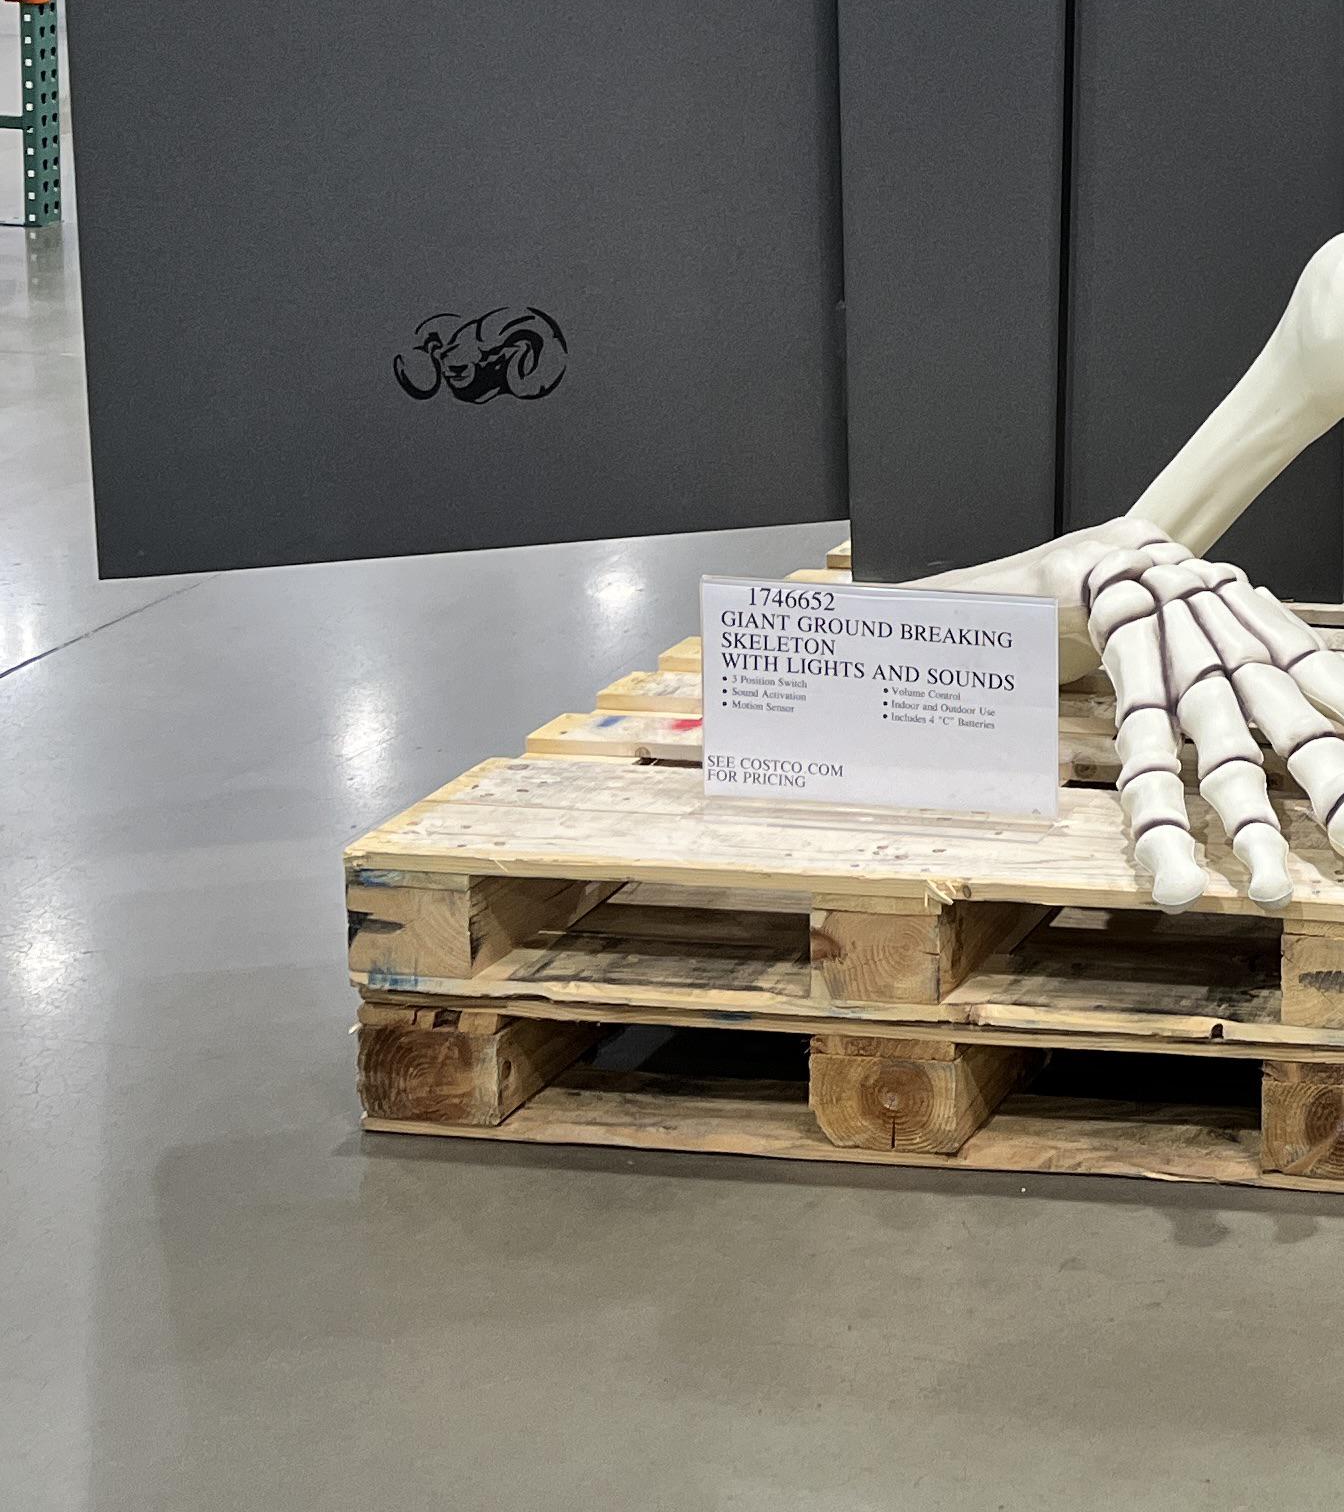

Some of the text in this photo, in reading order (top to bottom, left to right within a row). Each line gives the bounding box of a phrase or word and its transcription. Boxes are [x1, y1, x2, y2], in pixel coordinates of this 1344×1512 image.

[748, 587, 835, 611] 1746652
[721, 611, 1013, 649] GIANT GROUND BREAKING
[721, 632, 836, 656] SKELETON
[721, 653, 1015, 691] WITH LIGHTS AND SOUNDS
[732, 674, 808, 689] 3 Position Switch
[732, 687, 807, 701] Sound Activation
[892, 686, 961, 701] Volume Control
[732, 700, 795, 713] Motion Sensor
[891, 699, 996, 717] Indoor and Outdoor Use
[891, 712, 995, 729] Includes 4 "C" Batteries
[707, 755, 736, 768] SEE
[707, 769, 806, 788] FOR PRICING
